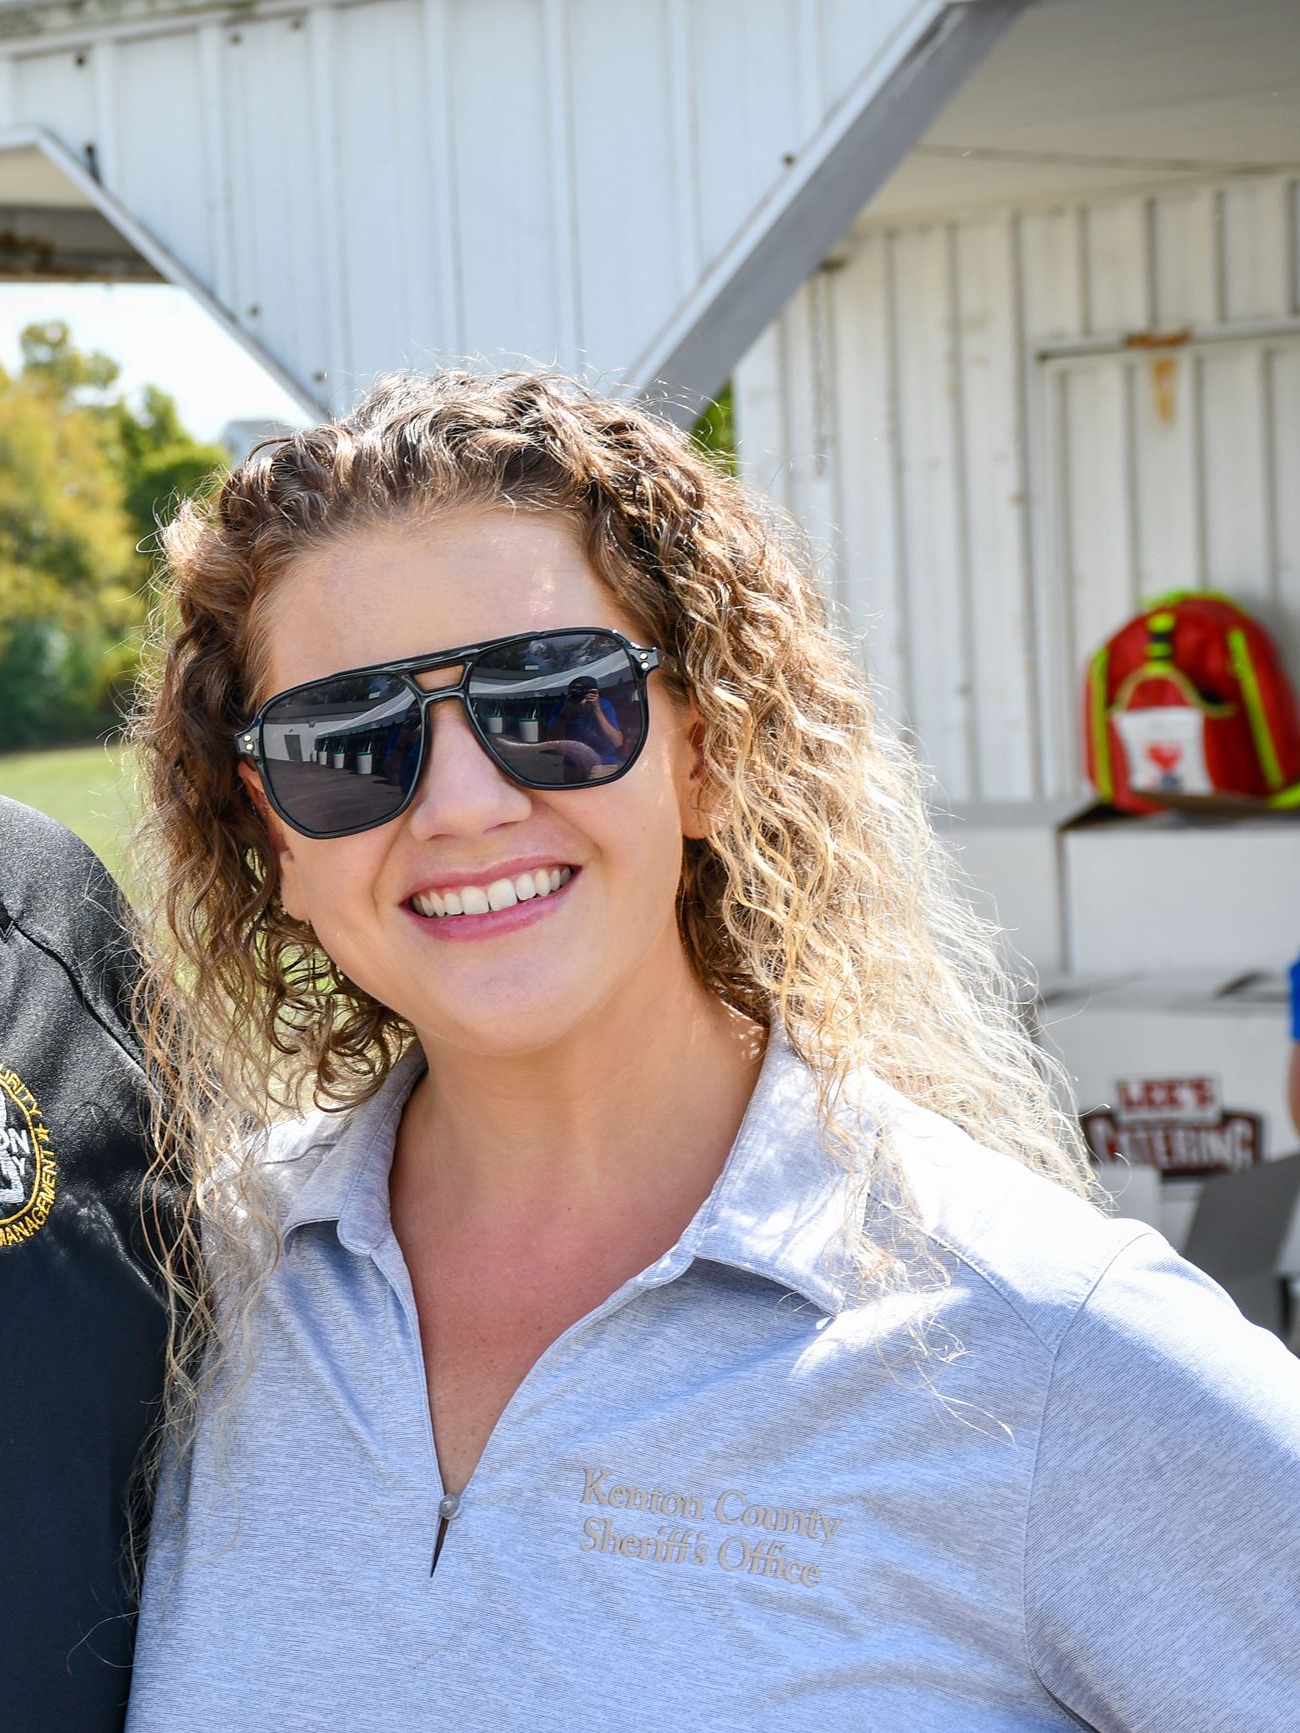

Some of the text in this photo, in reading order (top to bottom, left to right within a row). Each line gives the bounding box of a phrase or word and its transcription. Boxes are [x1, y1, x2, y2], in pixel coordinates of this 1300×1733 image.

[1117, 1075, 1215, 1109] LEE'S
[580, 1466, 842, 1548] Kenton County
[580, 1515, 822, 1589] Sheriff's Office
